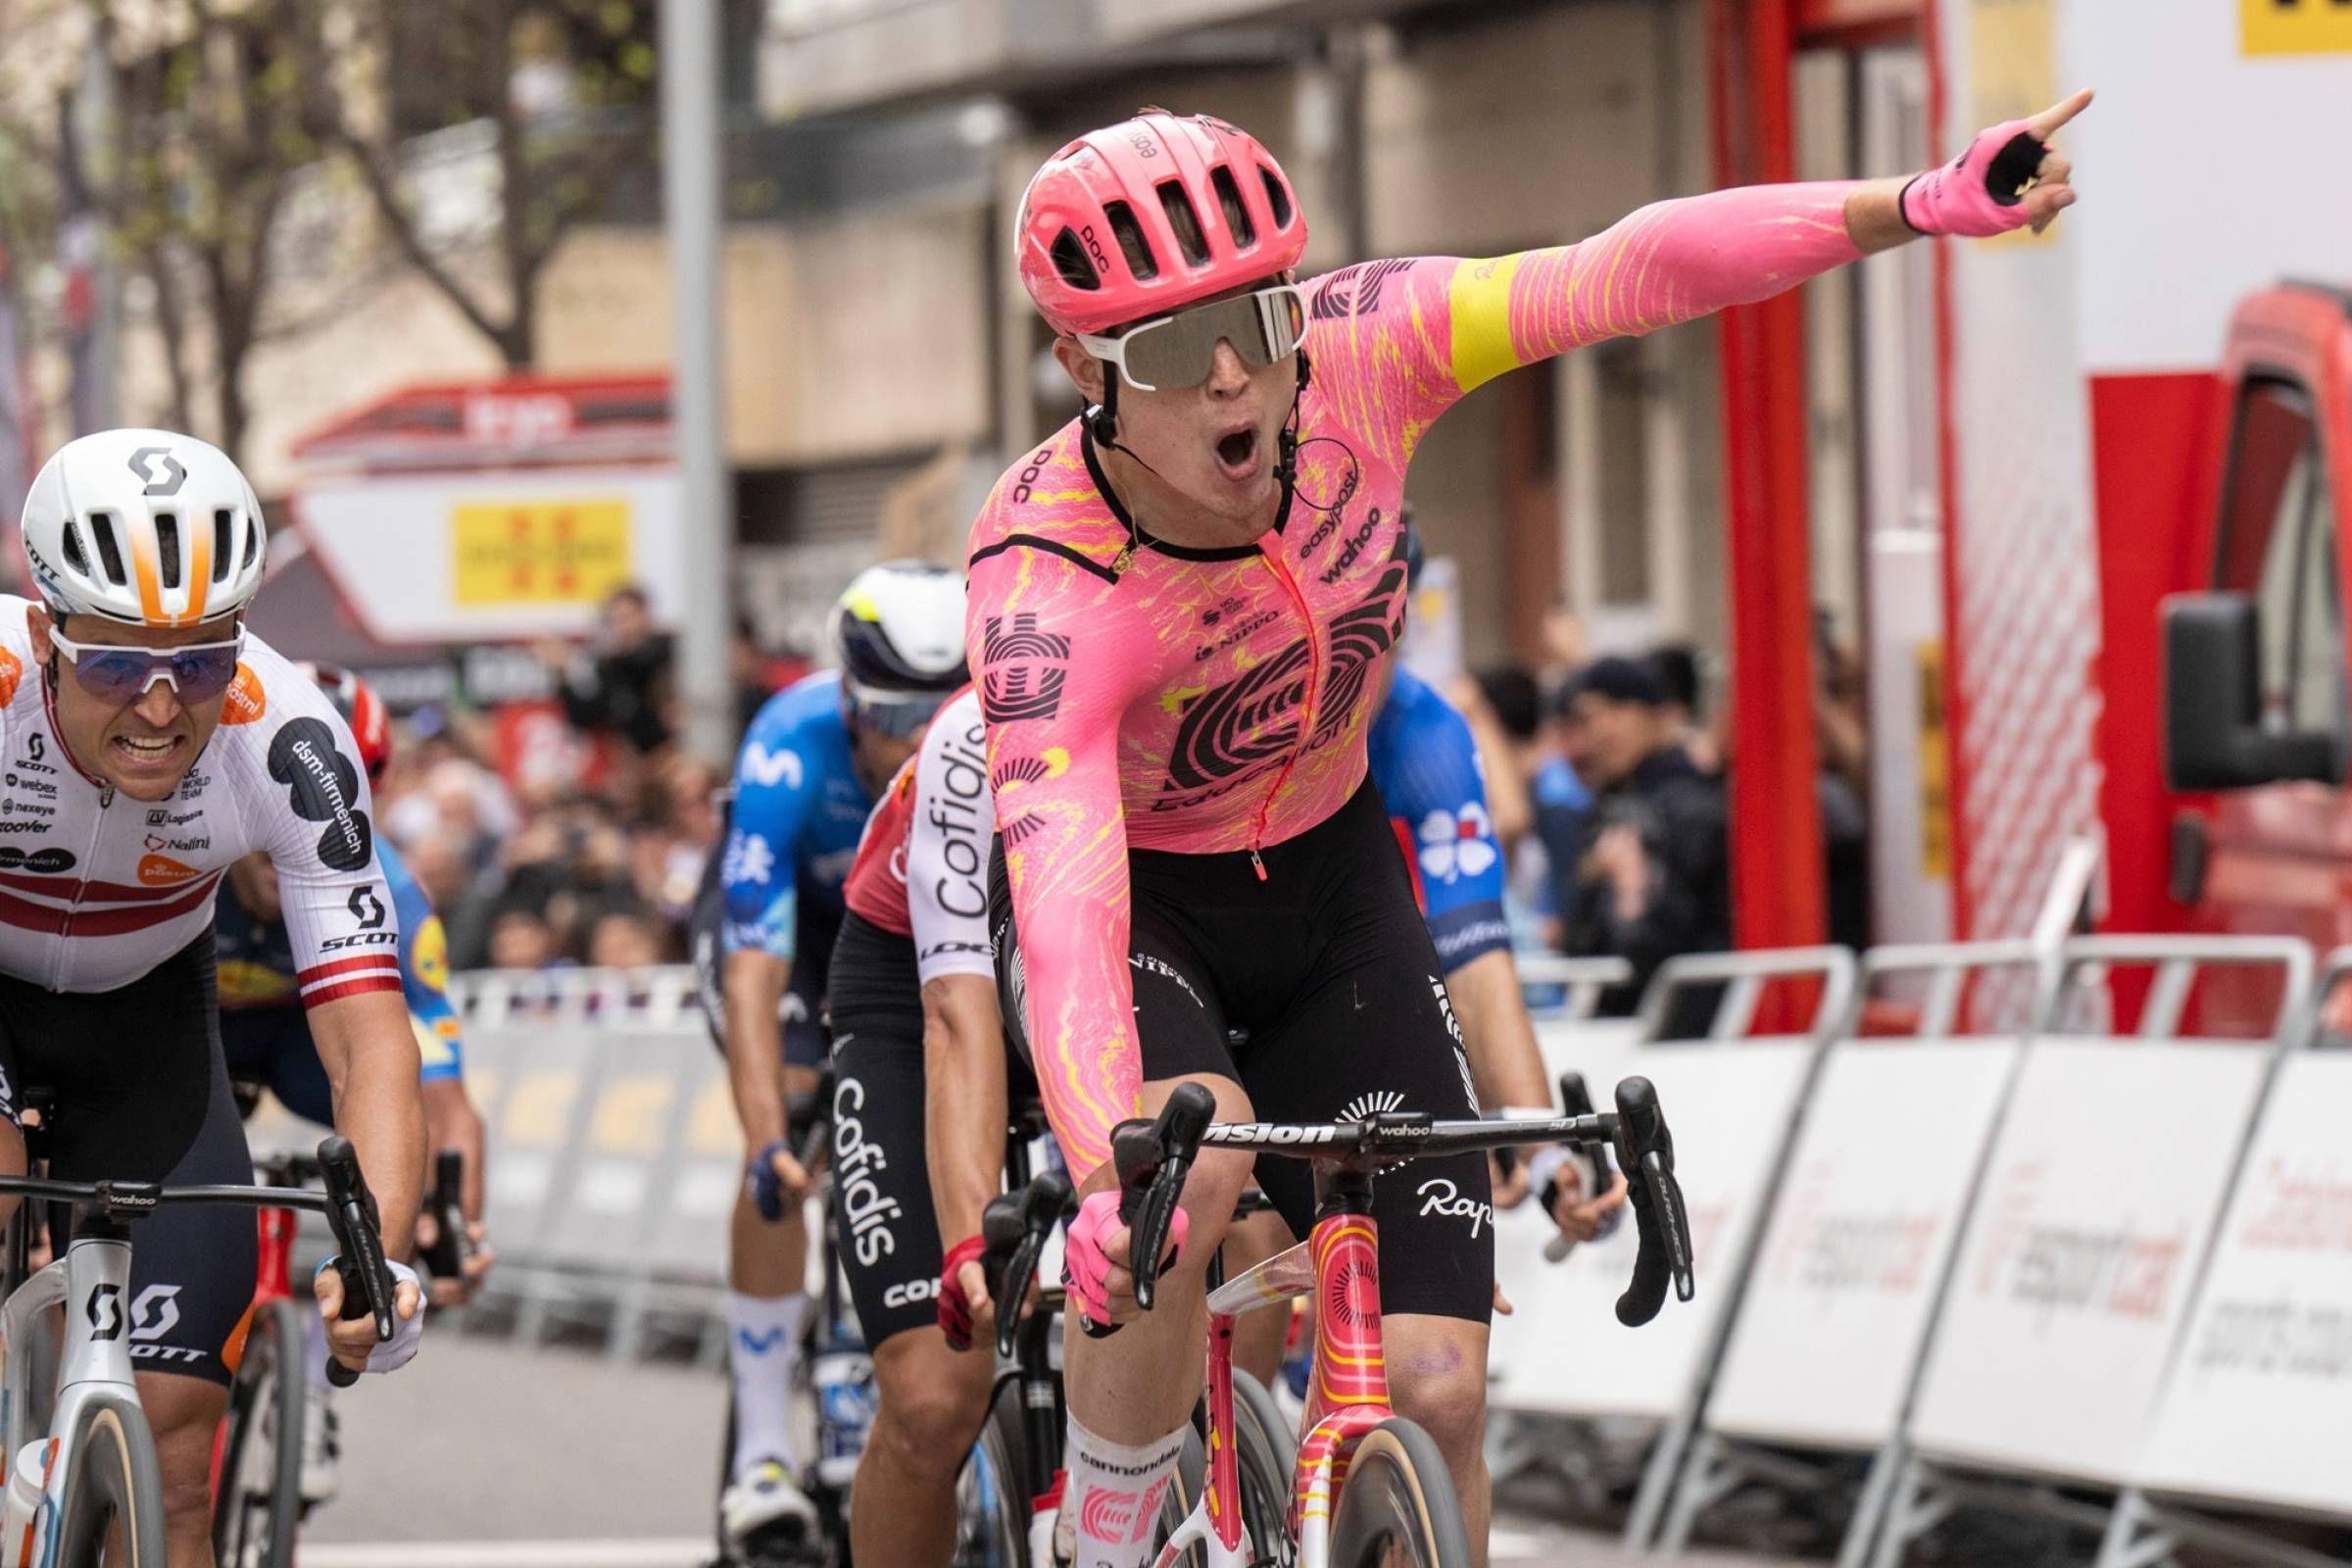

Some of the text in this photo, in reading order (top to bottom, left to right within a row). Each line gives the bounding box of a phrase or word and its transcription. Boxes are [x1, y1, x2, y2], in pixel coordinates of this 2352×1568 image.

[1300, 470, 1357, 559] easypost
[1319, 508, 1380, 584] wahoo
[1220, 611, 1279, 649] NIPPO
[16, 760, 59, 775] SCOTT
[1151, 712, 1351, 813] Educaion
[20, 780, 57, 794] webex
[292, 740, 361, 855] dsm-firmenich
[15, 804, 56, 816] nexeye
[168, 836, 211, 851] Nalini
[319, 932, 399, 954] SCOT
[1379, 1124, 1430, 1137] wahoo
[110, 1195, 157, 1205] wahoo
[1417, 1179, 1494, 1239] Rap
[128, 1344, 208, 1362] OTT
